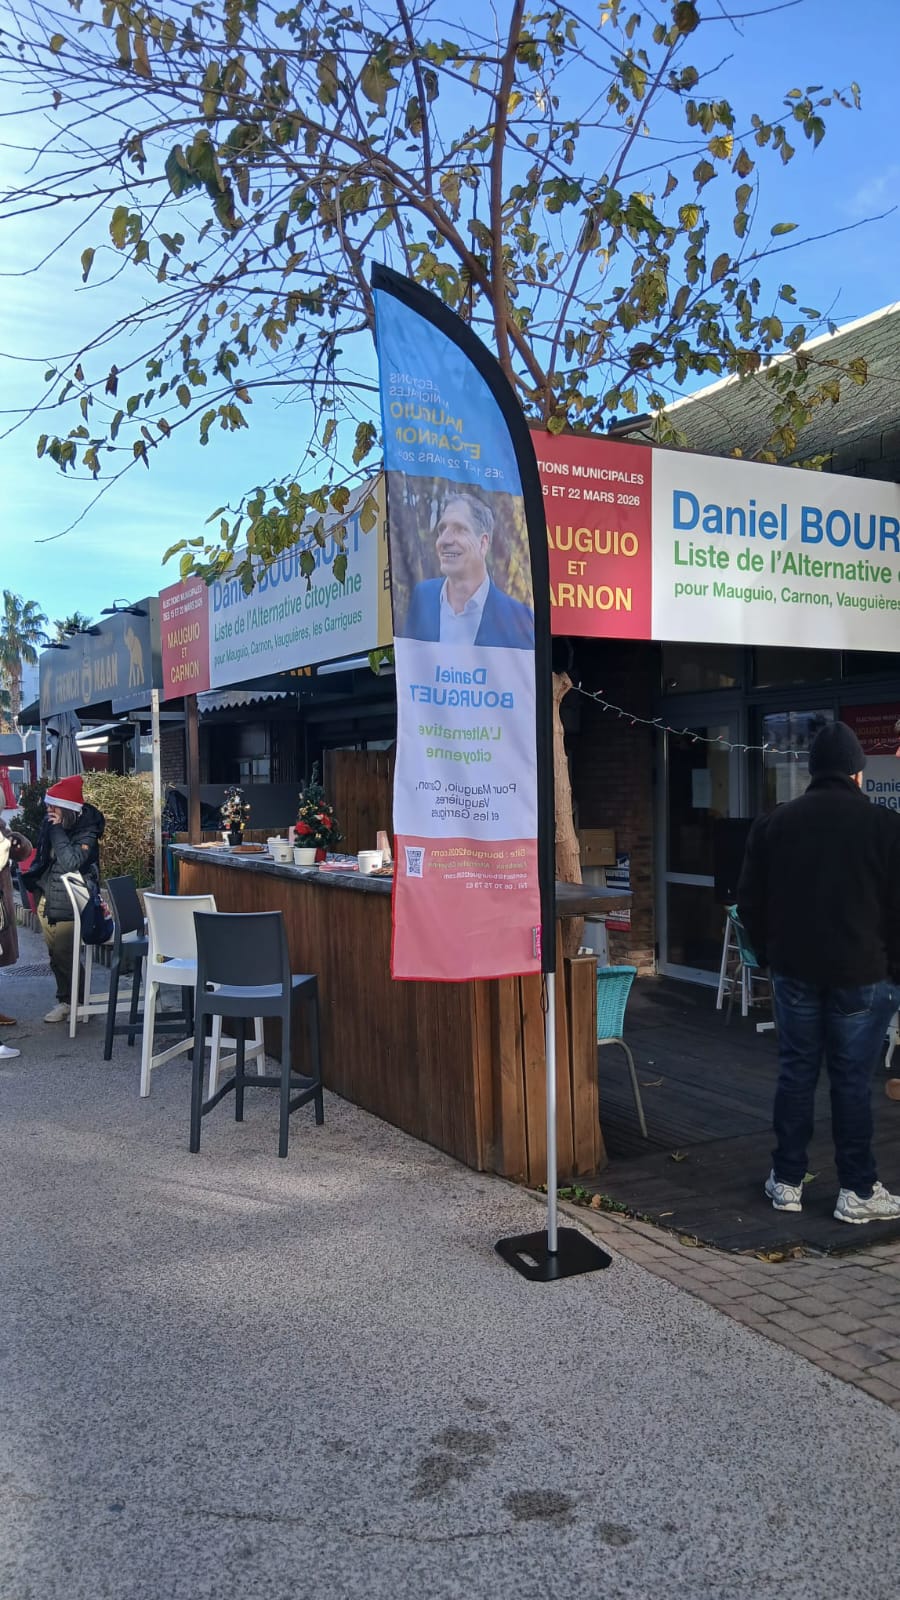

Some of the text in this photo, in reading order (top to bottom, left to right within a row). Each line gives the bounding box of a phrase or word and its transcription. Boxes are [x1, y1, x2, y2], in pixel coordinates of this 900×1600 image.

[537, 460, 644, 485] TIONS MUNICIPALES
[542, 485, 640, 506] 5 ET 22 MARS 2026
[672, 490, 788, 541] Daniel
[546, 524, 639, 557] UGUIO
[568, 560, 587, 576] ET
[674, 540, 730, 569] Liste
[736, 547, 764, 572] de
[770, 550, 892, 584] l’Alternative
[214, 623, 232, 642] Liste
[234, 616, 244, 635] de
[304, 573, 362, 608] citoyenne
[550, 583, 632, 612] RNON
[674, 582, 709, 598] pour
[713, 582, 777, 604] Mauguio,
[780, 587, 833, 608] Carnon,
[168, 622, 200, 649] MAUGUIO
[214, 652, 226, 669] pour
[251, 638, 273, 656] Carnon,
[274, 626, 312, 648] Vauguières,
[312, 622, 322, 638] les
[324, 610, 363, 632] Garrigues
[182, 648, 187, 659] ET
[170, 662, 200, 684] CARNON
